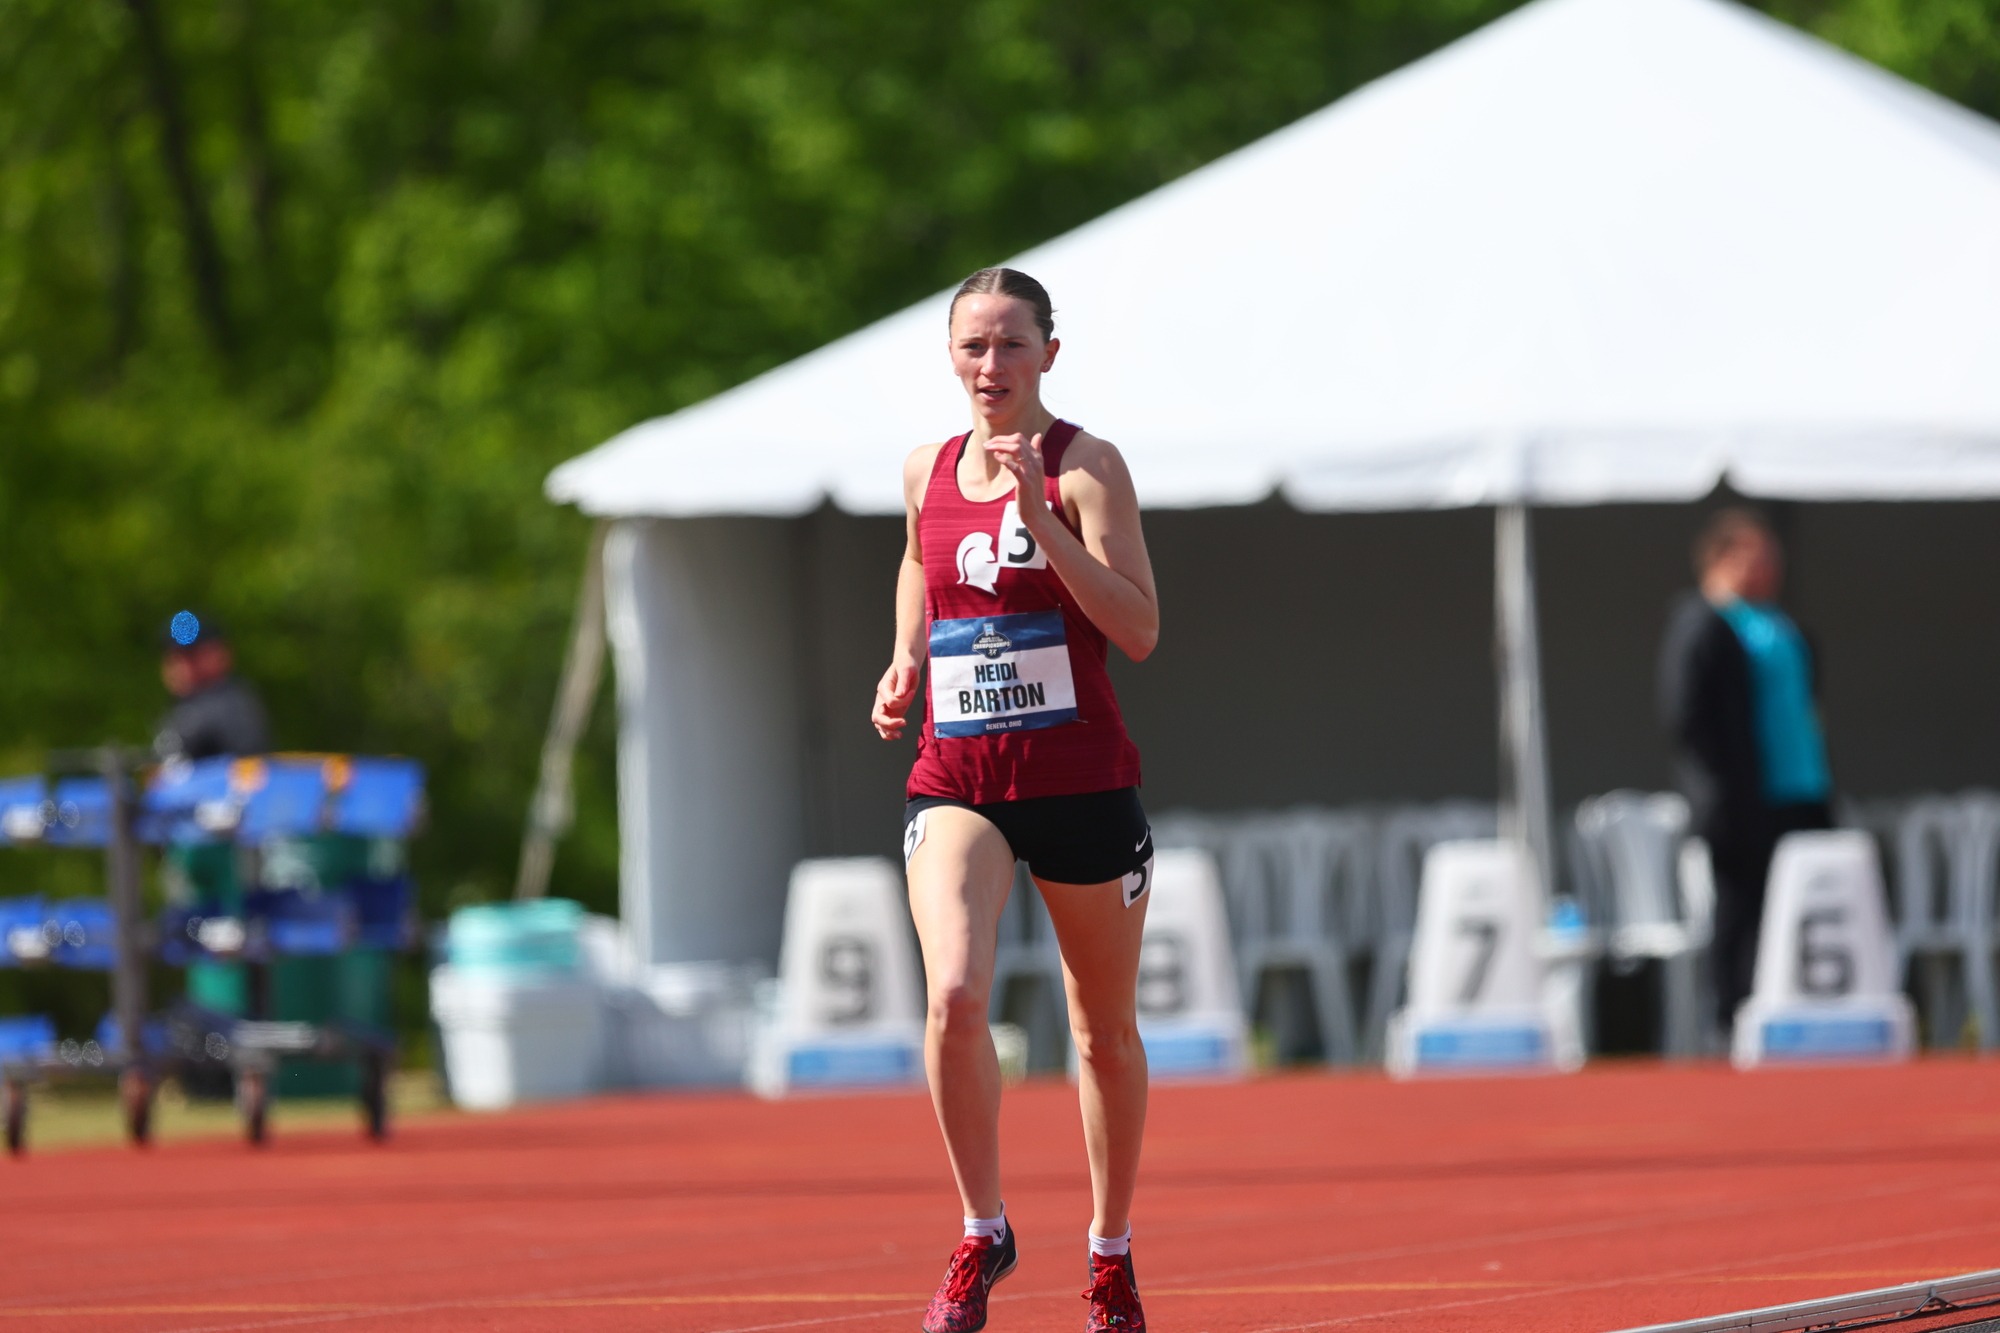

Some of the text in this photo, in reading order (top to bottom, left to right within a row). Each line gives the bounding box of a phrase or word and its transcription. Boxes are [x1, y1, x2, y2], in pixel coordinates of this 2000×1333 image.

[959, 682, 1046, 715] BARTON
[974, 662, 1018, 683] HEIDI
[985, 719, 1023, 731] GENEVA, OHIO
[821, 936, 875, 1021] 9
[1456, 917, 1501, 1004] 7
[1796, 907, 1854, 997] 6
